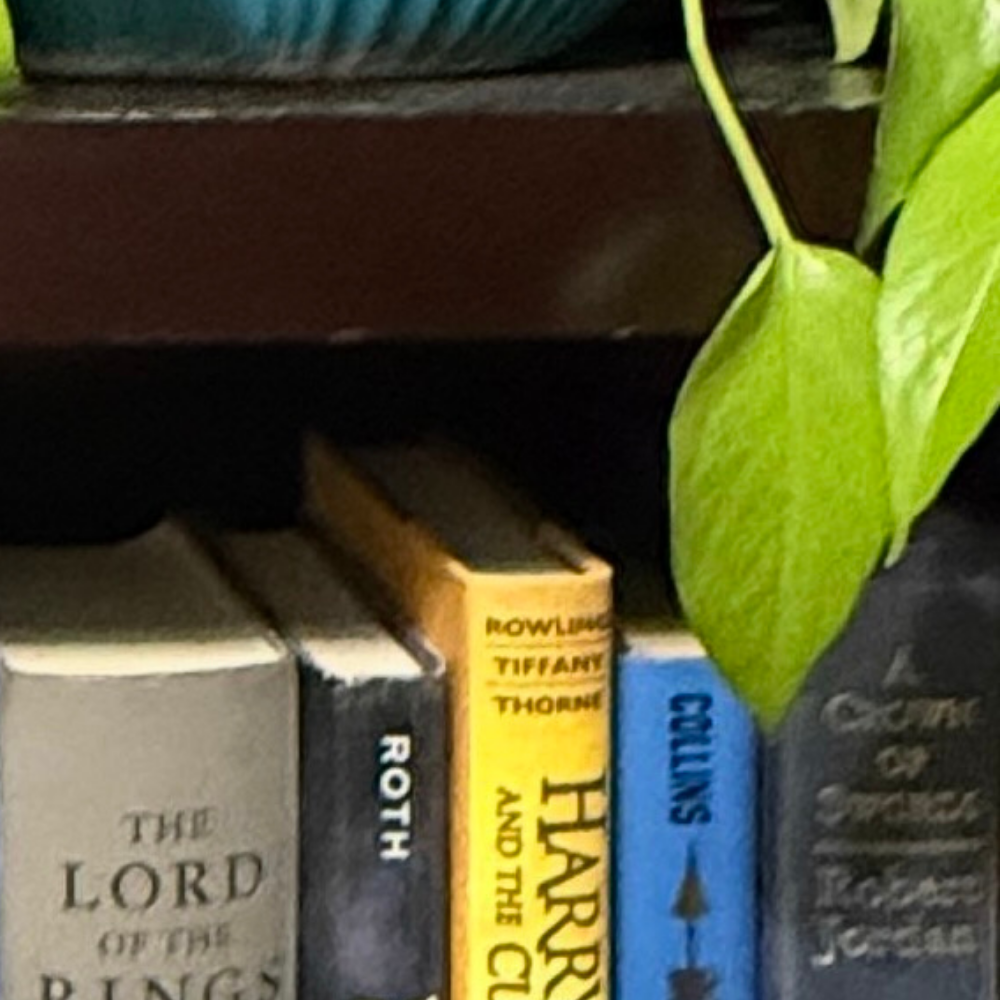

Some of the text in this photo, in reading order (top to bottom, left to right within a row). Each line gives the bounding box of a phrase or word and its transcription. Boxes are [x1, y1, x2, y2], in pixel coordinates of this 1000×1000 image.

[493, 654, 604, 677] TIFFANY
[492, 691, 603, 716] THORNE
[669, 693, 712, 827] COLLINS
[120, 807, 216, 845] THE
[379, 734, 411, 861] ROTH
[495, 786, 523, 858] AND
[61, 852, 263, 912] LORD
[495, 866, 523, 926] THE
[97, 922, 231, 957] OF THE
